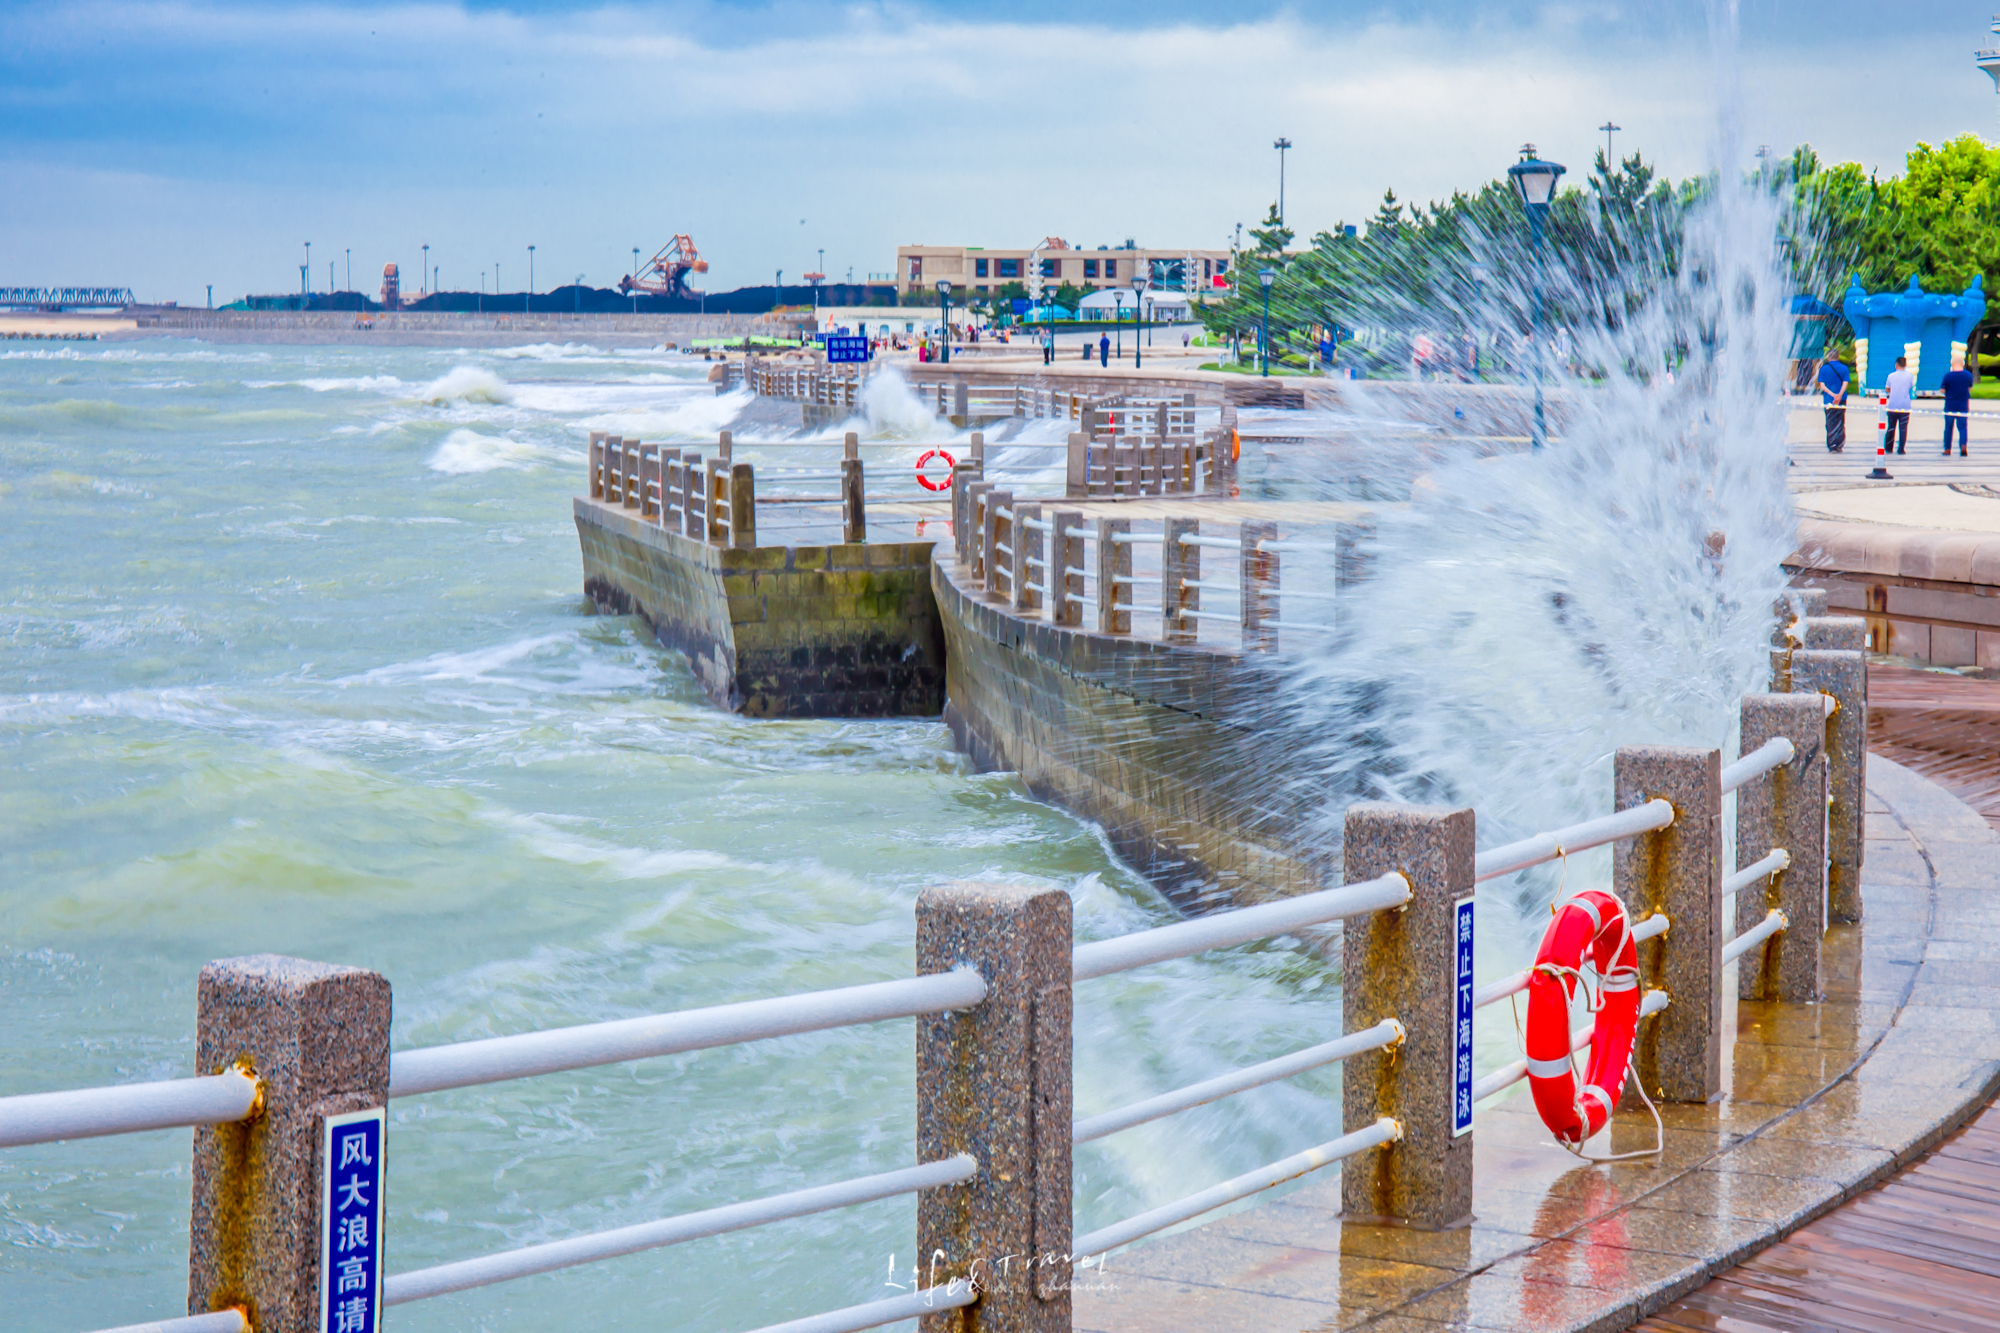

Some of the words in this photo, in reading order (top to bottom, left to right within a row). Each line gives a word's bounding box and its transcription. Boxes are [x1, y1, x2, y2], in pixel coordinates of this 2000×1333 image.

[1458, 913, 1471, 1119] 禁止下海游泳
[334, 1132, 371, 1333] 风大浪高请
